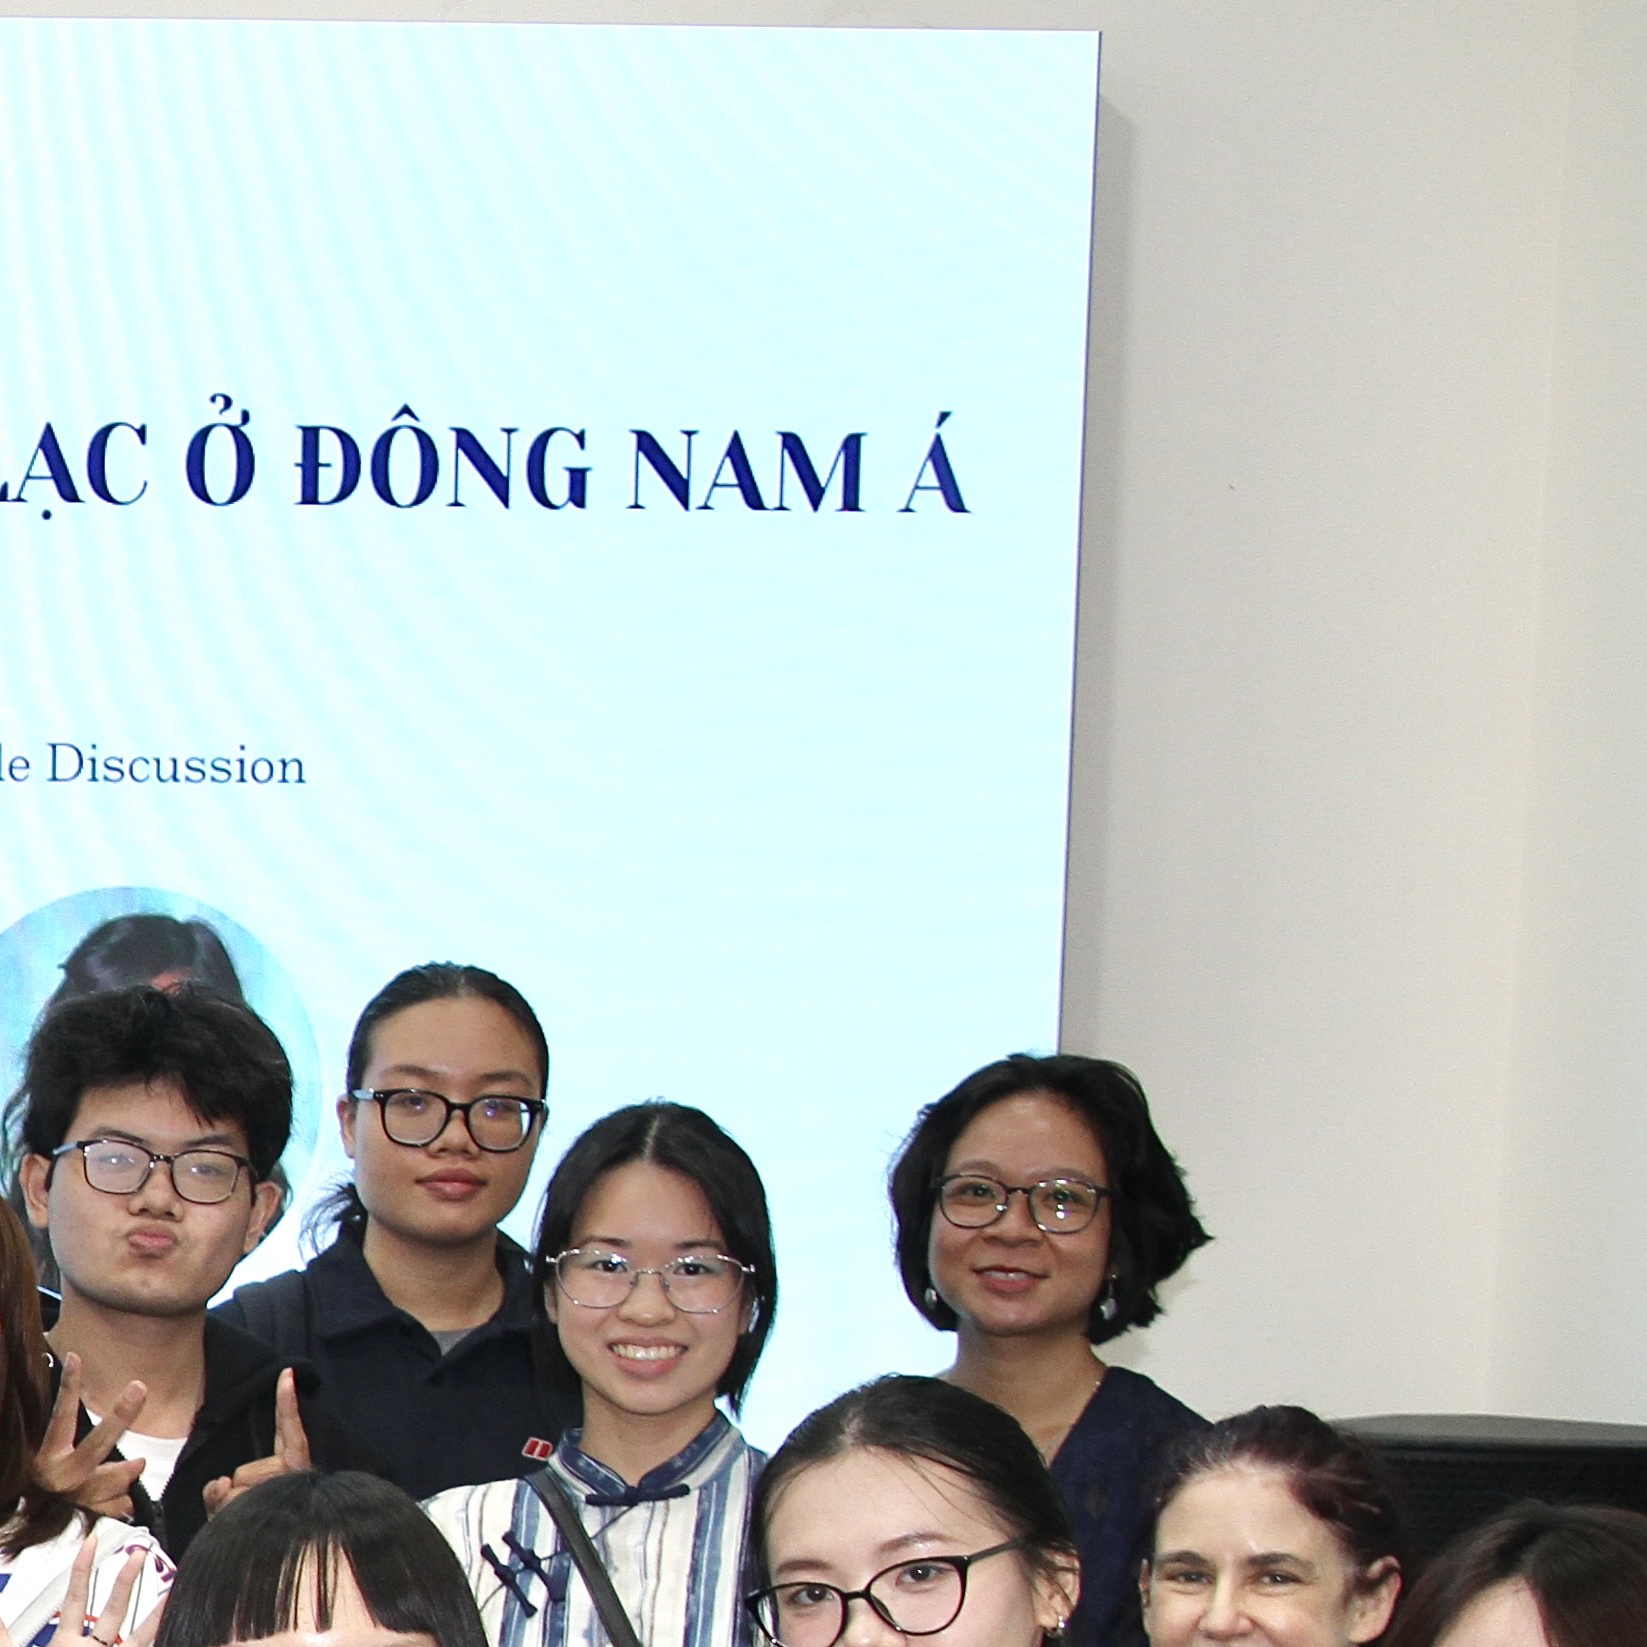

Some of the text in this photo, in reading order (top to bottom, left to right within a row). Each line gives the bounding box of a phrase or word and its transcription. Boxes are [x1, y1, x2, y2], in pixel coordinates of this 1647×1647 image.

[186, 393, 257, 507] Ở
[294, 405, 594, 512] ĐÔNG
[627, 429, 869, 514] NAM
[898, 409, 973, 514] Á
[47, 743, 308, 785] Discussion
